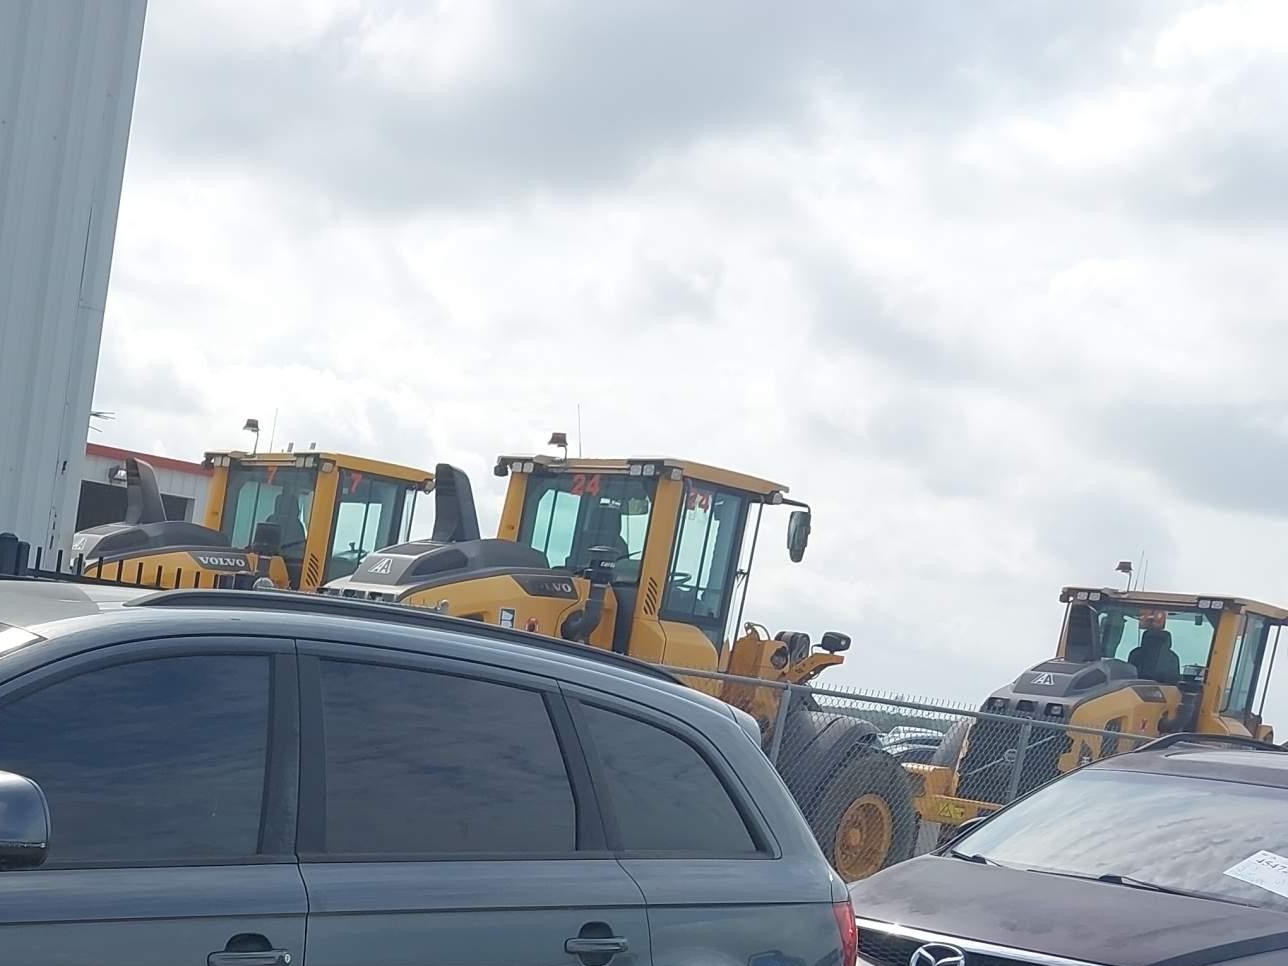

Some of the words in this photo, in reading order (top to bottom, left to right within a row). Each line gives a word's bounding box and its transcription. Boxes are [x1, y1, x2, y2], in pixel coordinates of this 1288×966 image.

[350, 472, 363, 493] 7
[570, 473, 601, 496] 24
[199, 556, 246, 567] VOLVO
